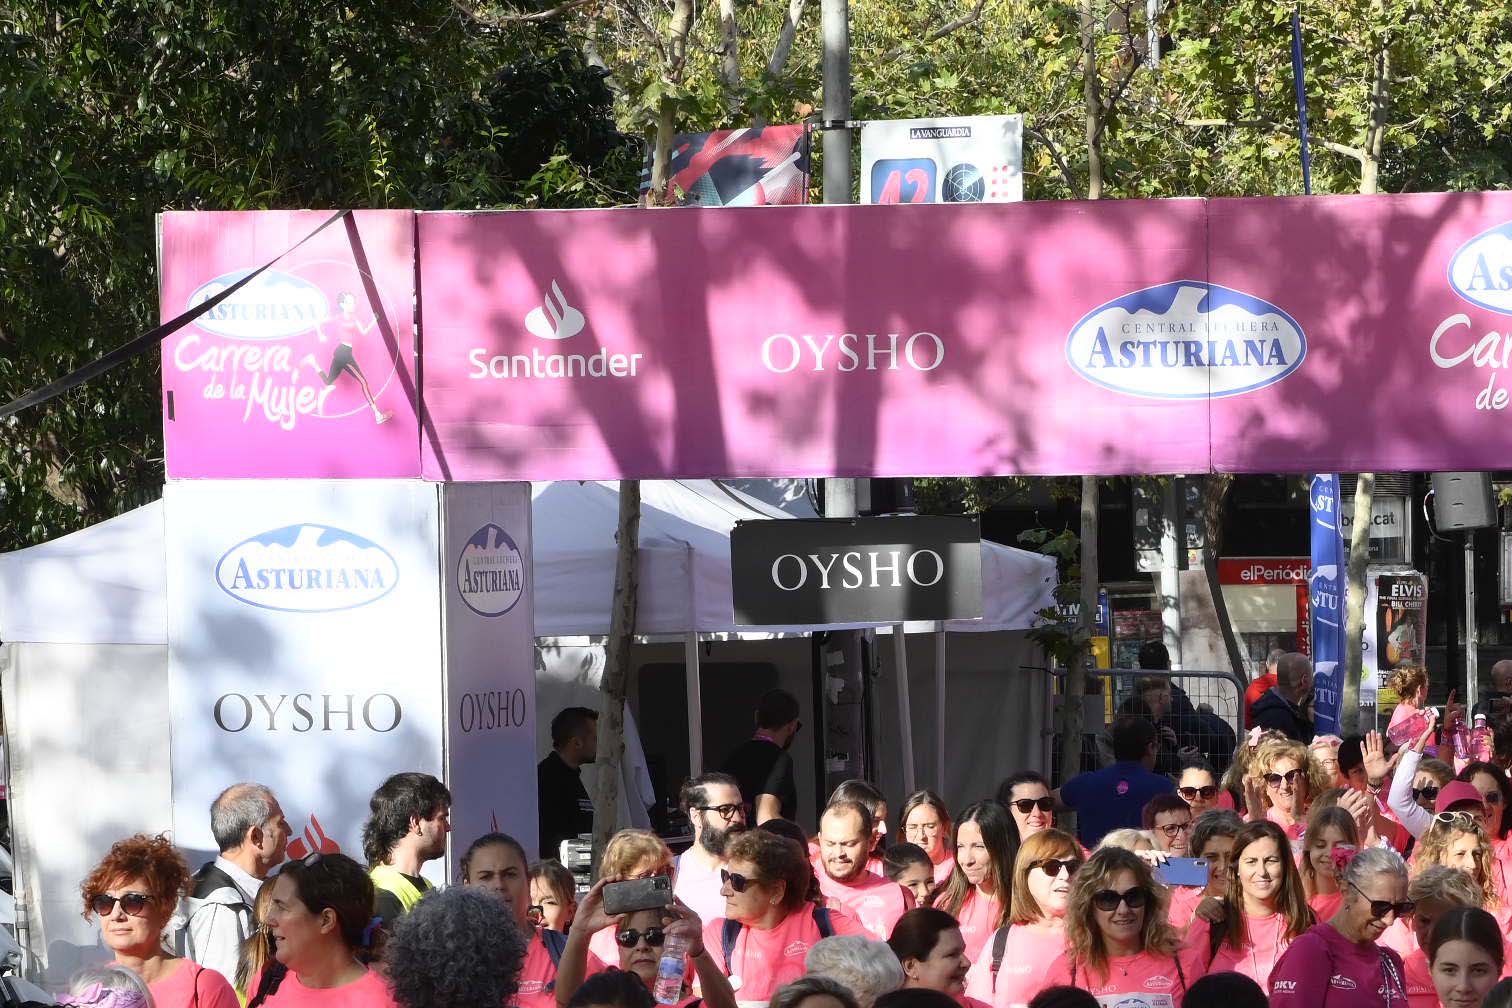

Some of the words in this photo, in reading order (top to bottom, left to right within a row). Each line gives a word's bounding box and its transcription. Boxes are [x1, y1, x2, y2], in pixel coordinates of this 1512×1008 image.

[920, 127, 970, 138] VANGUARDIA
[1121, 322, 1196, 334] CENTRAL
[174, 334, 292, 372] Carrera
[468, 347, 643, 378] Santander
[760, 331, 945, 374] OYSHO
[1086, 326, 1289, 369] ASTURIANA
[203, 375, 225, 399] de
[230, 370, 246, 400] la
[243, 369, 337, 431] Mujer
[1475, 369, 1509, 410] de
[230, 556, 386, 590] ASTURIANA
[462, 558, 520, 595] ASTURIANA
[771, 549, 945, 592] OYSHO
[1391, 584, 1422, 597] ELVIS
[213, 692, 403, 733] OYSHO
[459, 687, 526, 733] OYSHO
[1274, 981, 1297, 990] DKV
